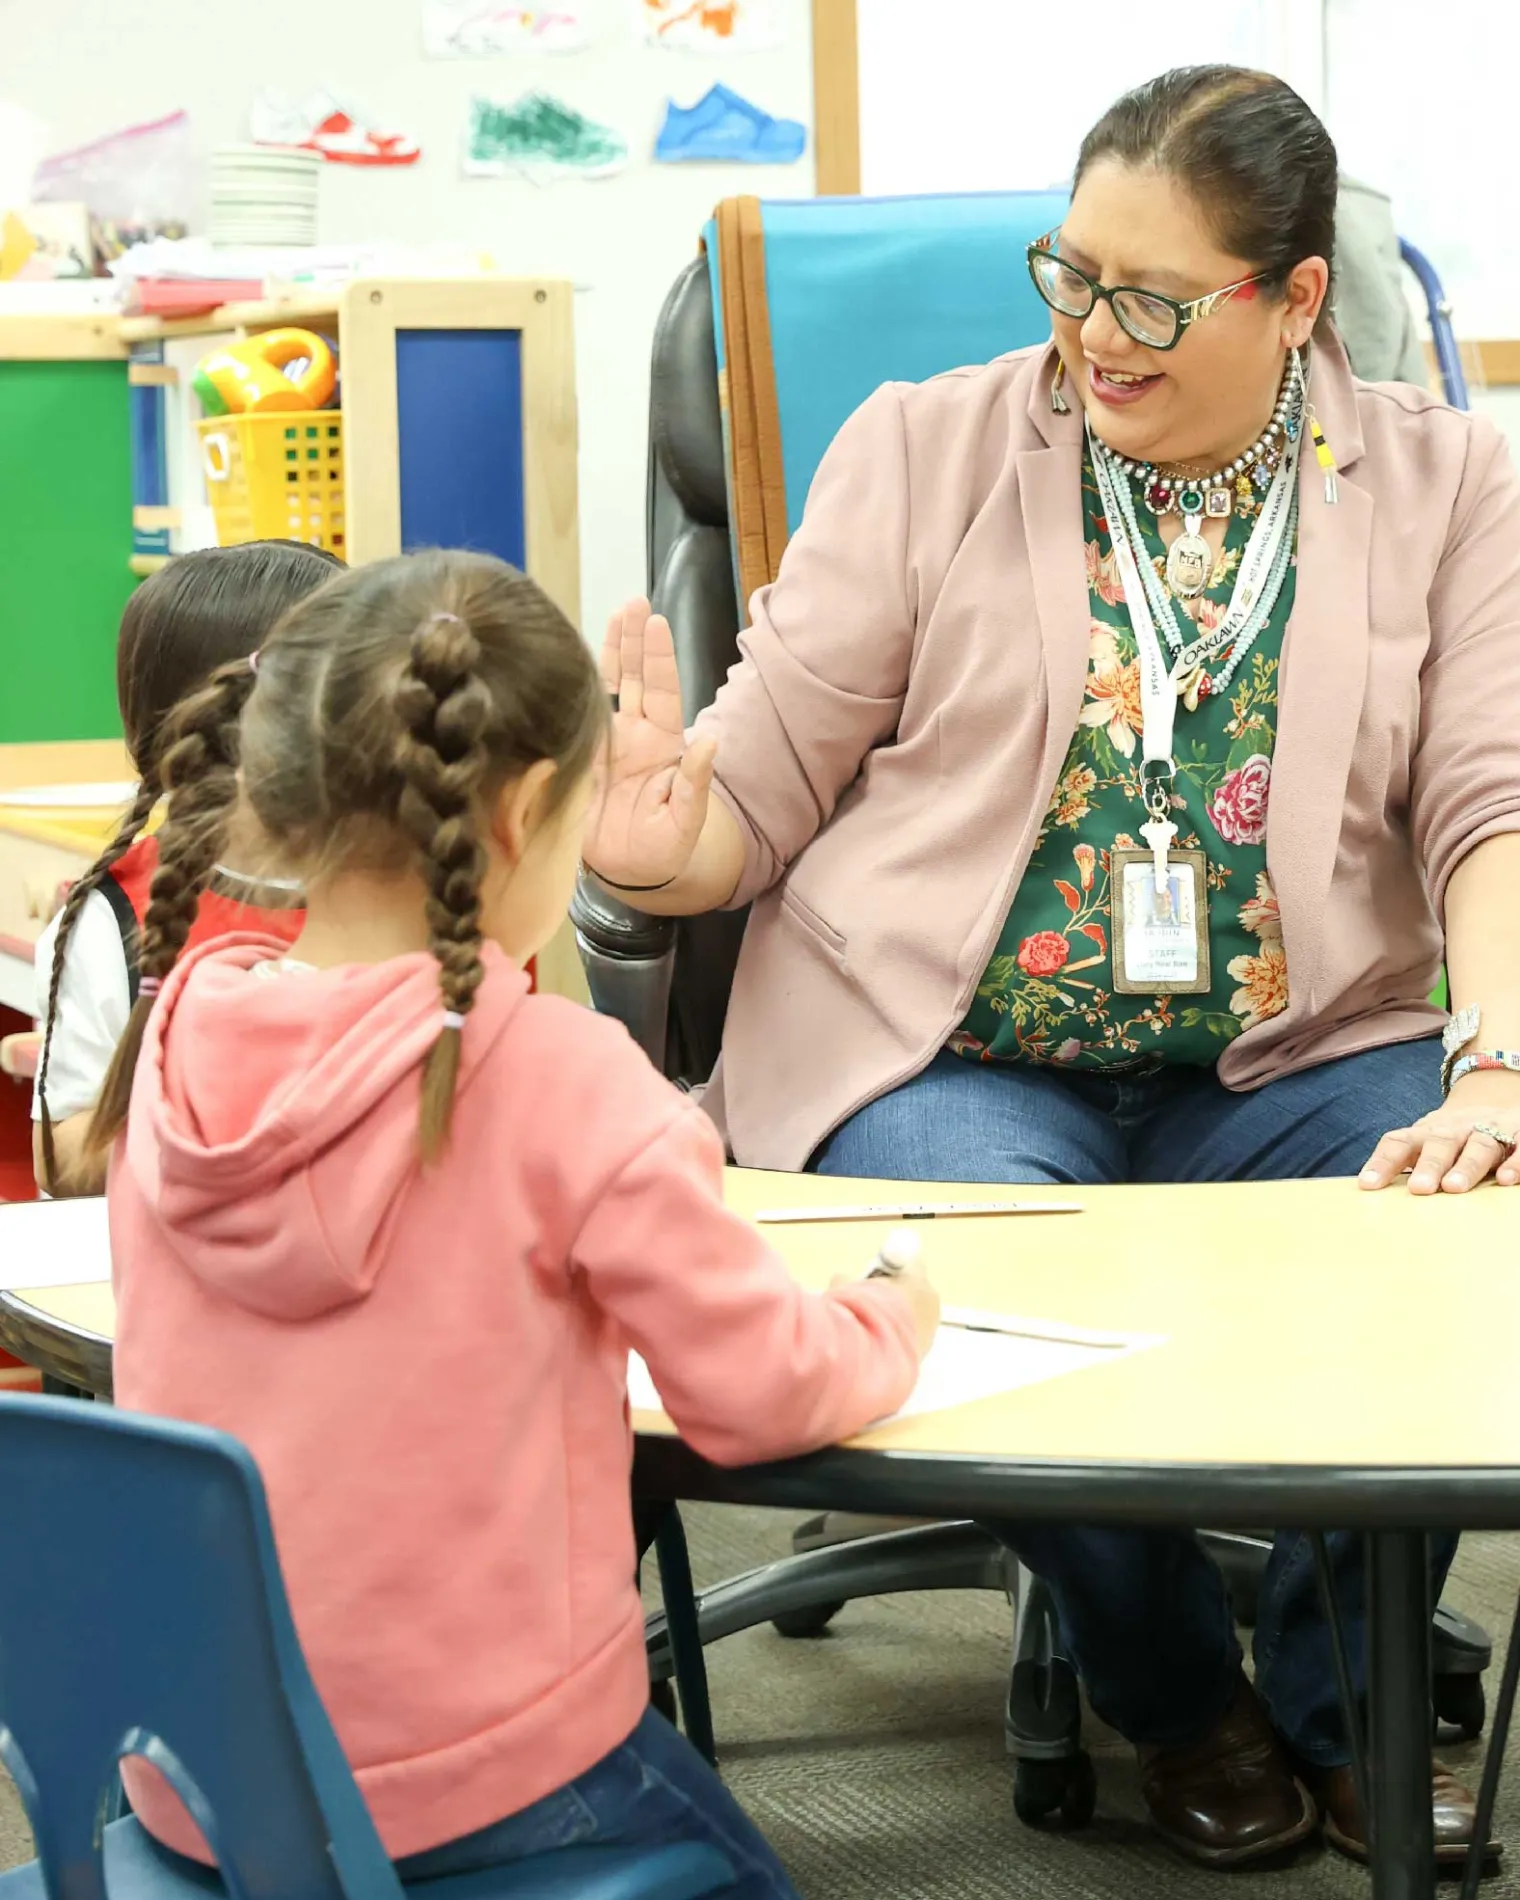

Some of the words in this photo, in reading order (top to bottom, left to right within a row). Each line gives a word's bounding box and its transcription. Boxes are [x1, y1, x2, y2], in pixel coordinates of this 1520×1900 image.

[1268, 481, 1287, 527] ARKANSAS
[1184, 607, 1245, 665] OAKLAWN
[1149, 949, 1176, 958] STAFF
